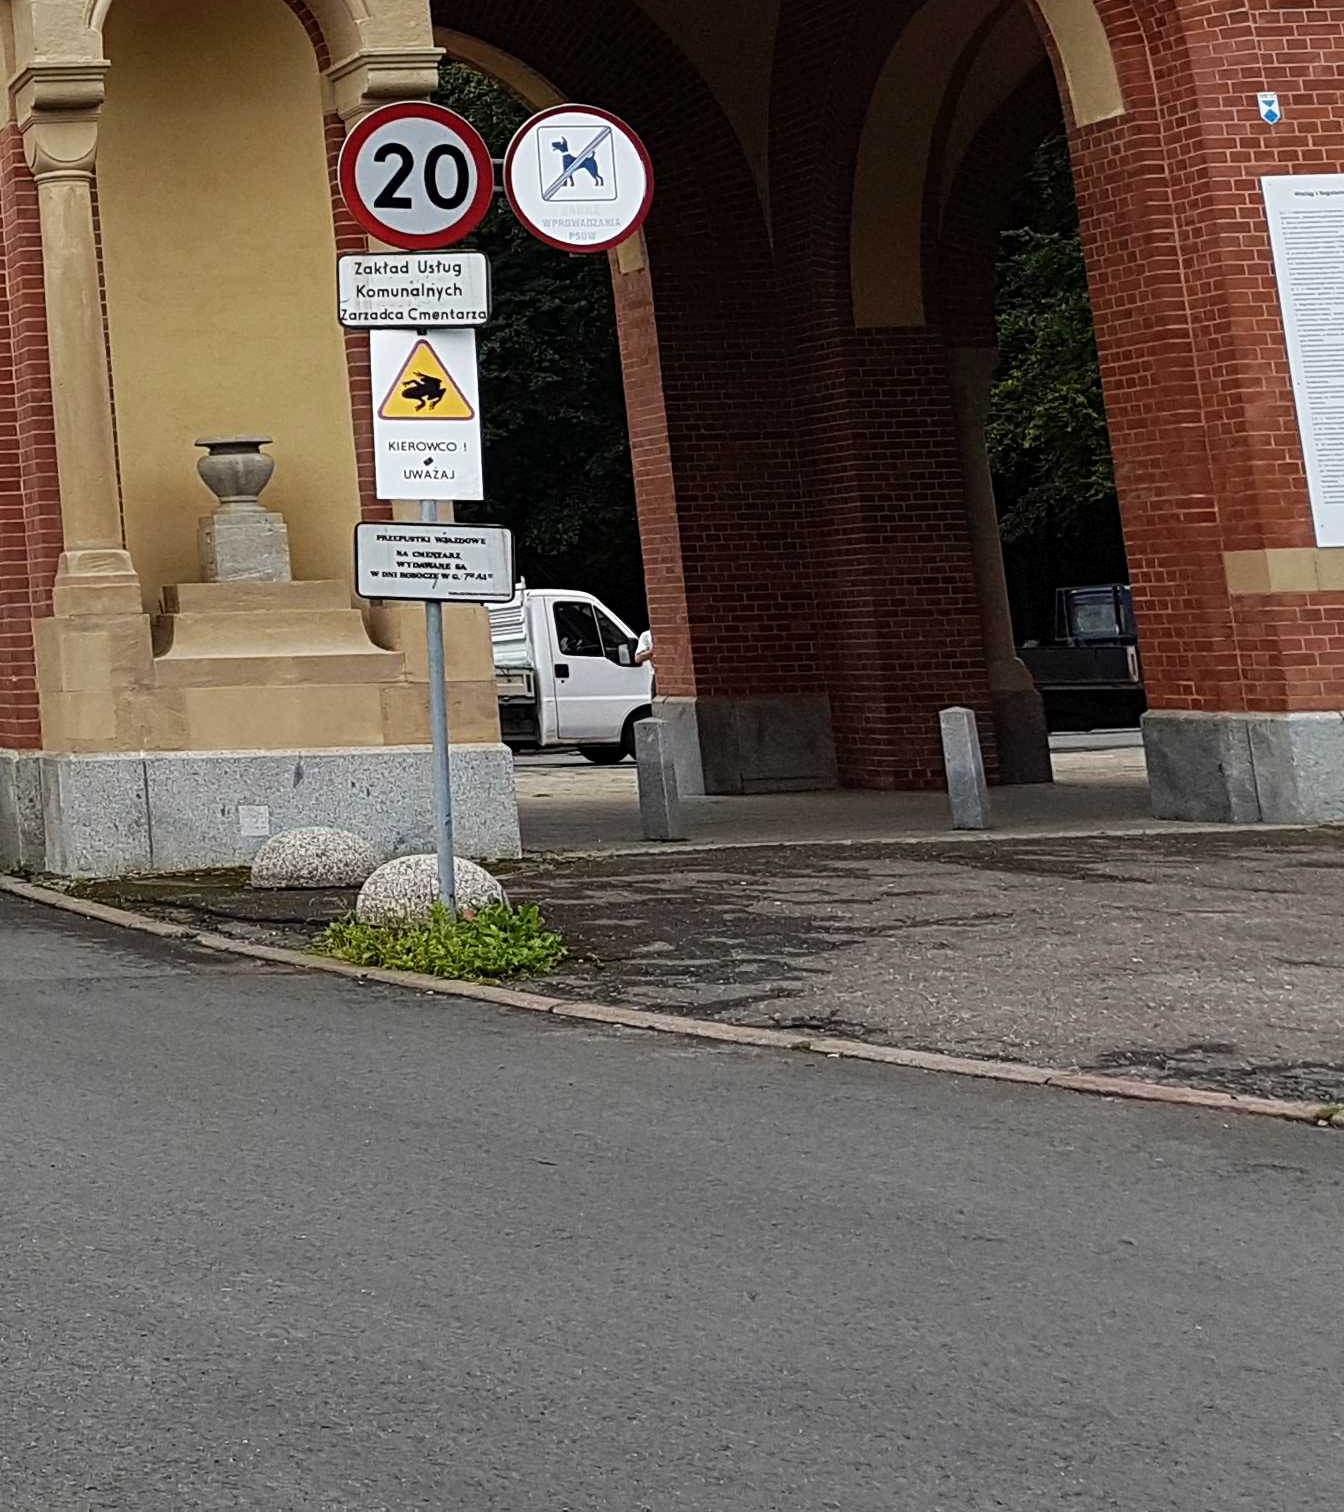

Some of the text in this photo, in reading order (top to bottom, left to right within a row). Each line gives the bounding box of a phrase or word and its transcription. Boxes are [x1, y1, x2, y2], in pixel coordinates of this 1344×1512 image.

[373, 142, 470, 210] 20
[354, 260, 462, 277] Zakład Usług
[356, 283, 463, 301] Komunalnych
[408, 308, 487, 320] Cmentarza
[388, 441, 457, 452] KIEROWCO
[403, 466, 455, 480] UWAŻAJ
